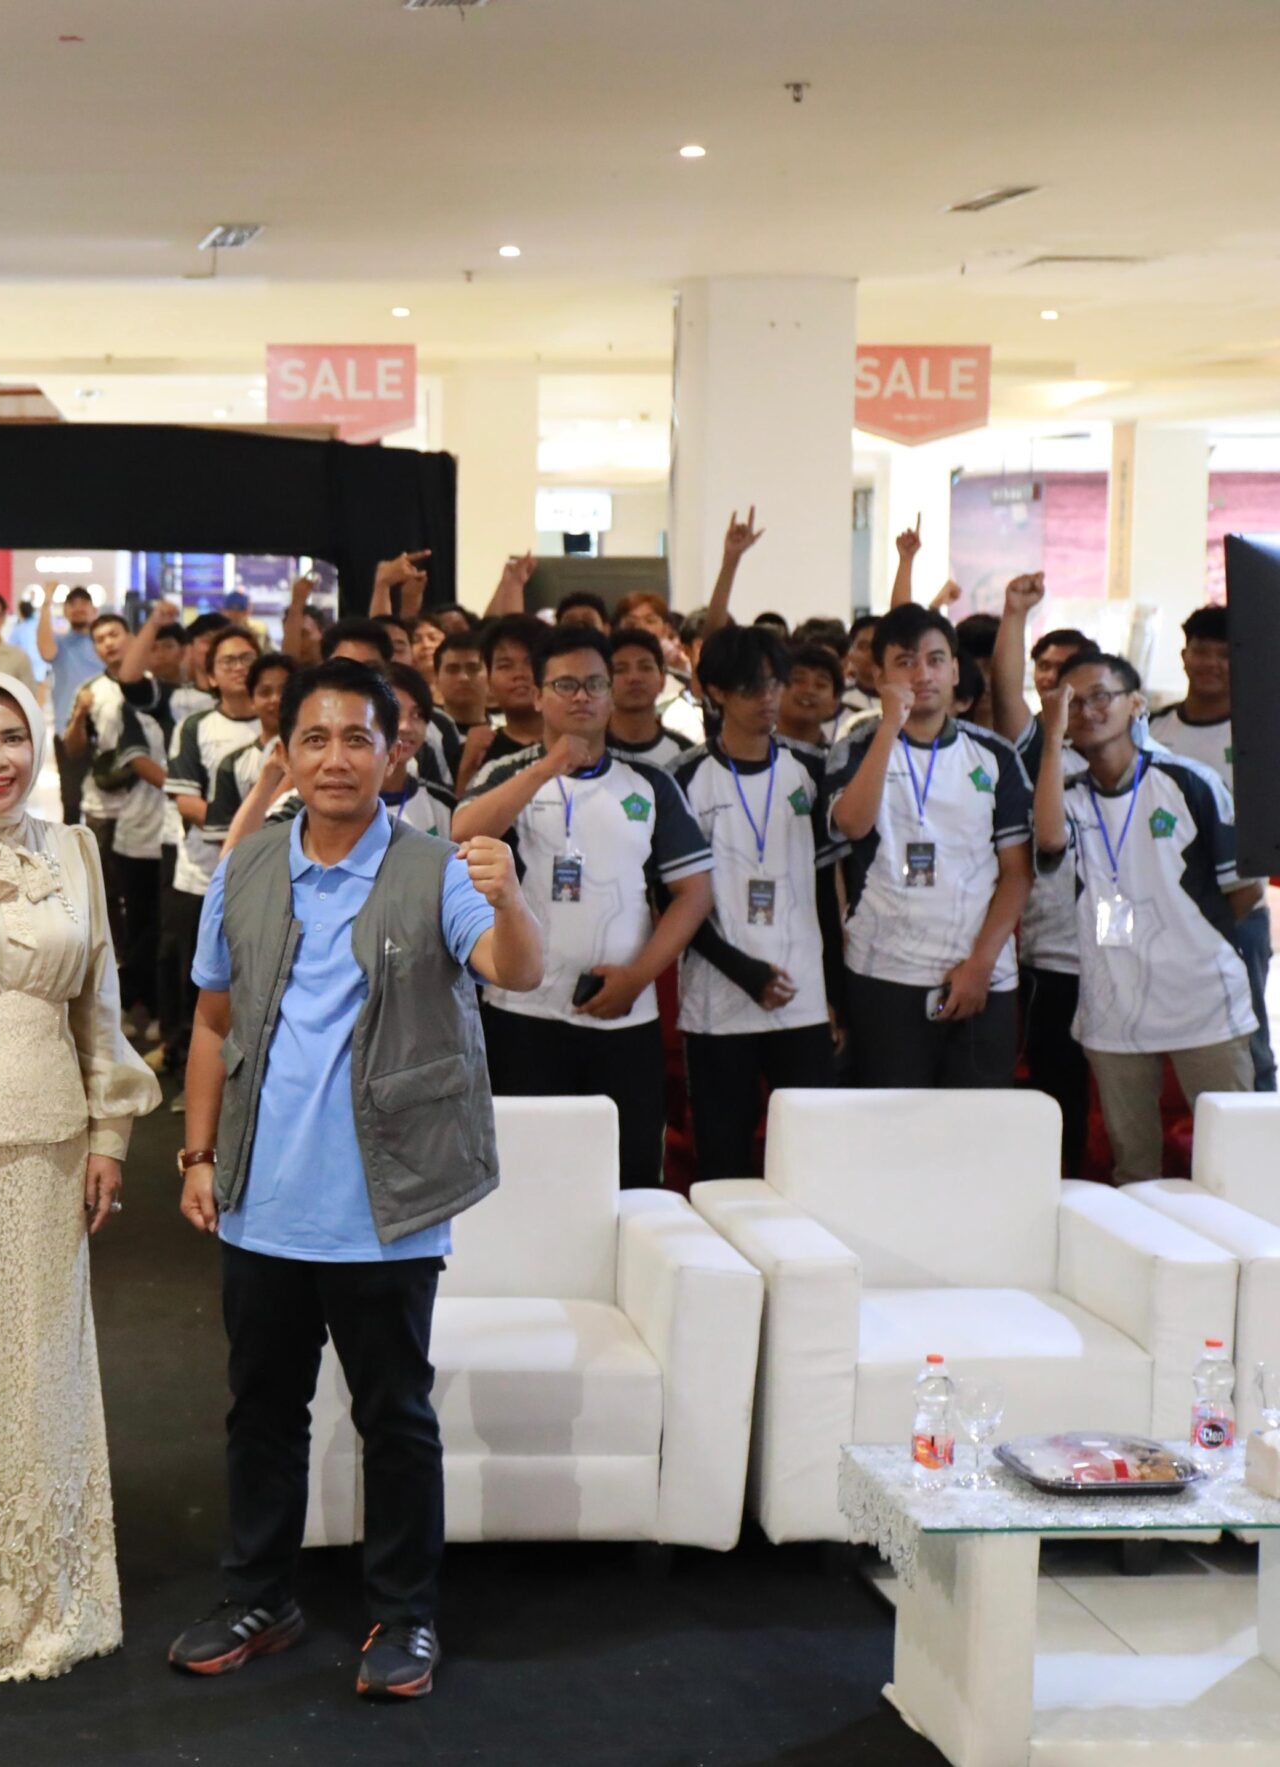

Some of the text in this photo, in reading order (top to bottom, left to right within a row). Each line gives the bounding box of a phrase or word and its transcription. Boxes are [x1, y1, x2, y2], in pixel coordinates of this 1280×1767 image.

[278, 357, 404, 401] SALE
[855, 356, 977, 400] SALE
[1203, 1427, 1224, 1442] Cleo
